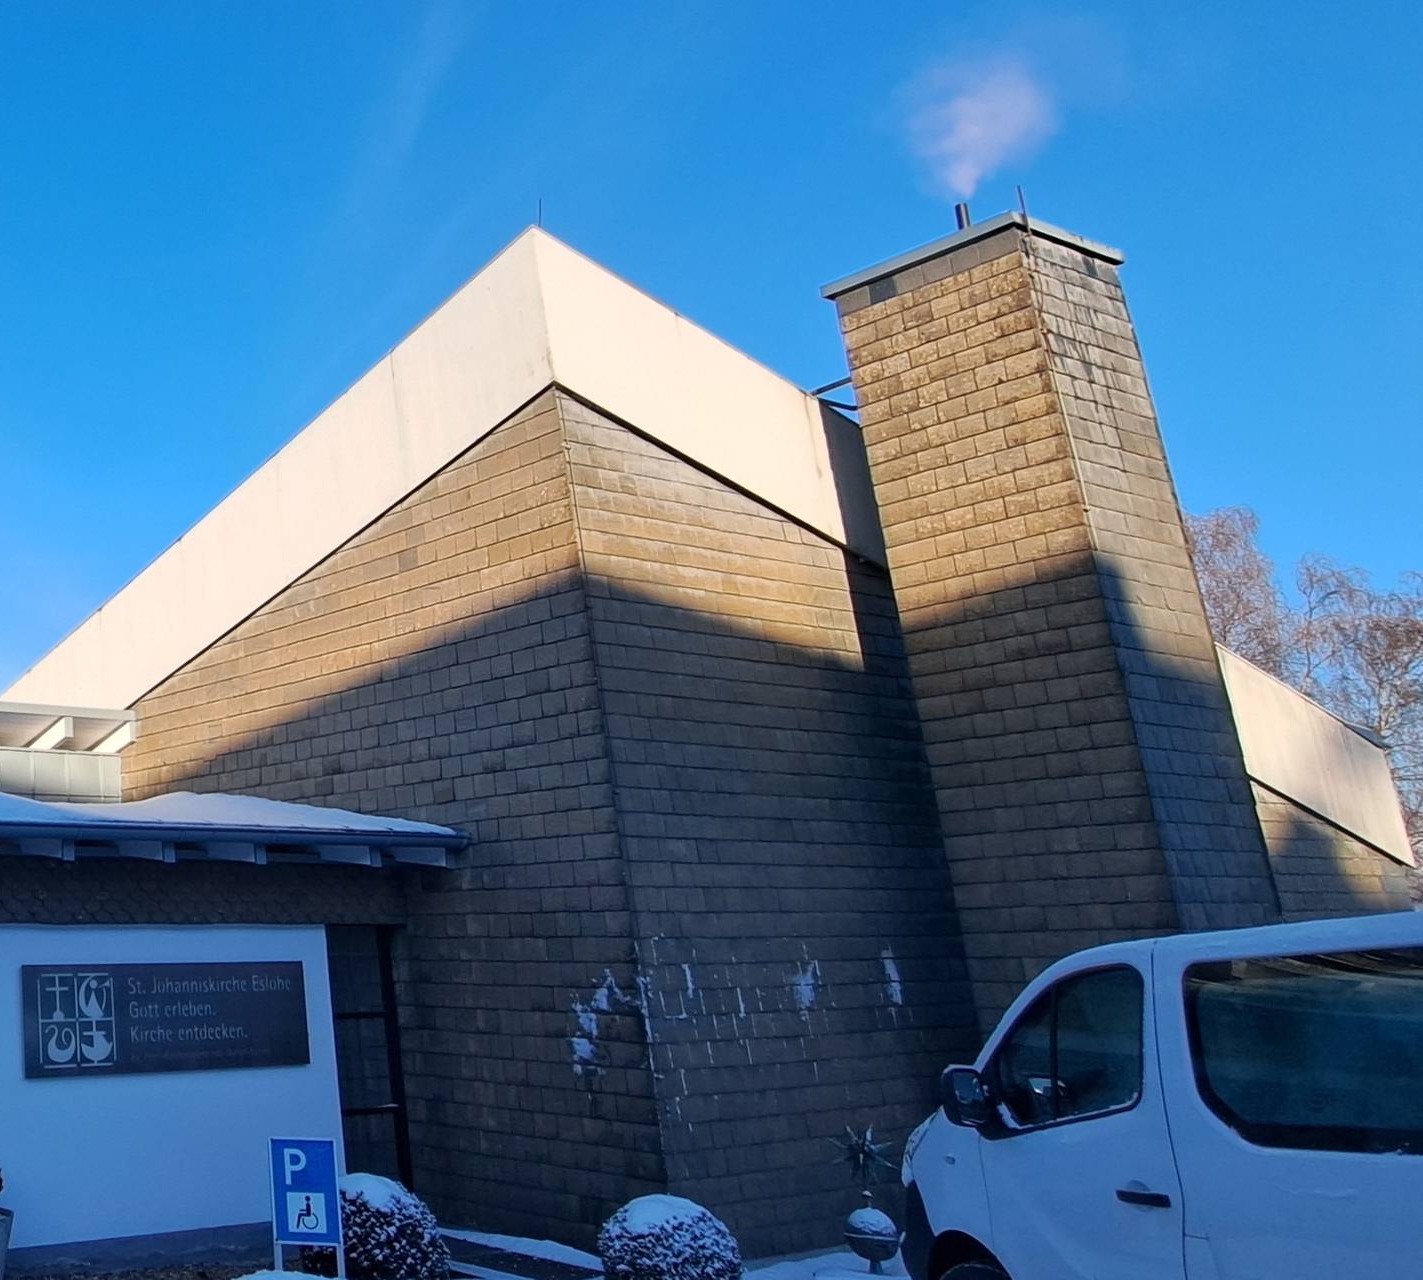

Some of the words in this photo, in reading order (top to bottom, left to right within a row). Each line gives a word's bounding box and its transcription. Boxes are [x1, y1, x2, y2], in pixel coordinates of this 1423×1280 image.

[128, 977, 147, 995] St.
[151, 976, 247, 994] Johanniskirche
[129, 1001, 160, 1018] Gott
[164, 1000, 217, 1018] erleben.
[130, 1025, 173, 1043] Kirche
[178, 1023, 249, 1041] entdecken.
[283, 1148, 307, 1185] P
